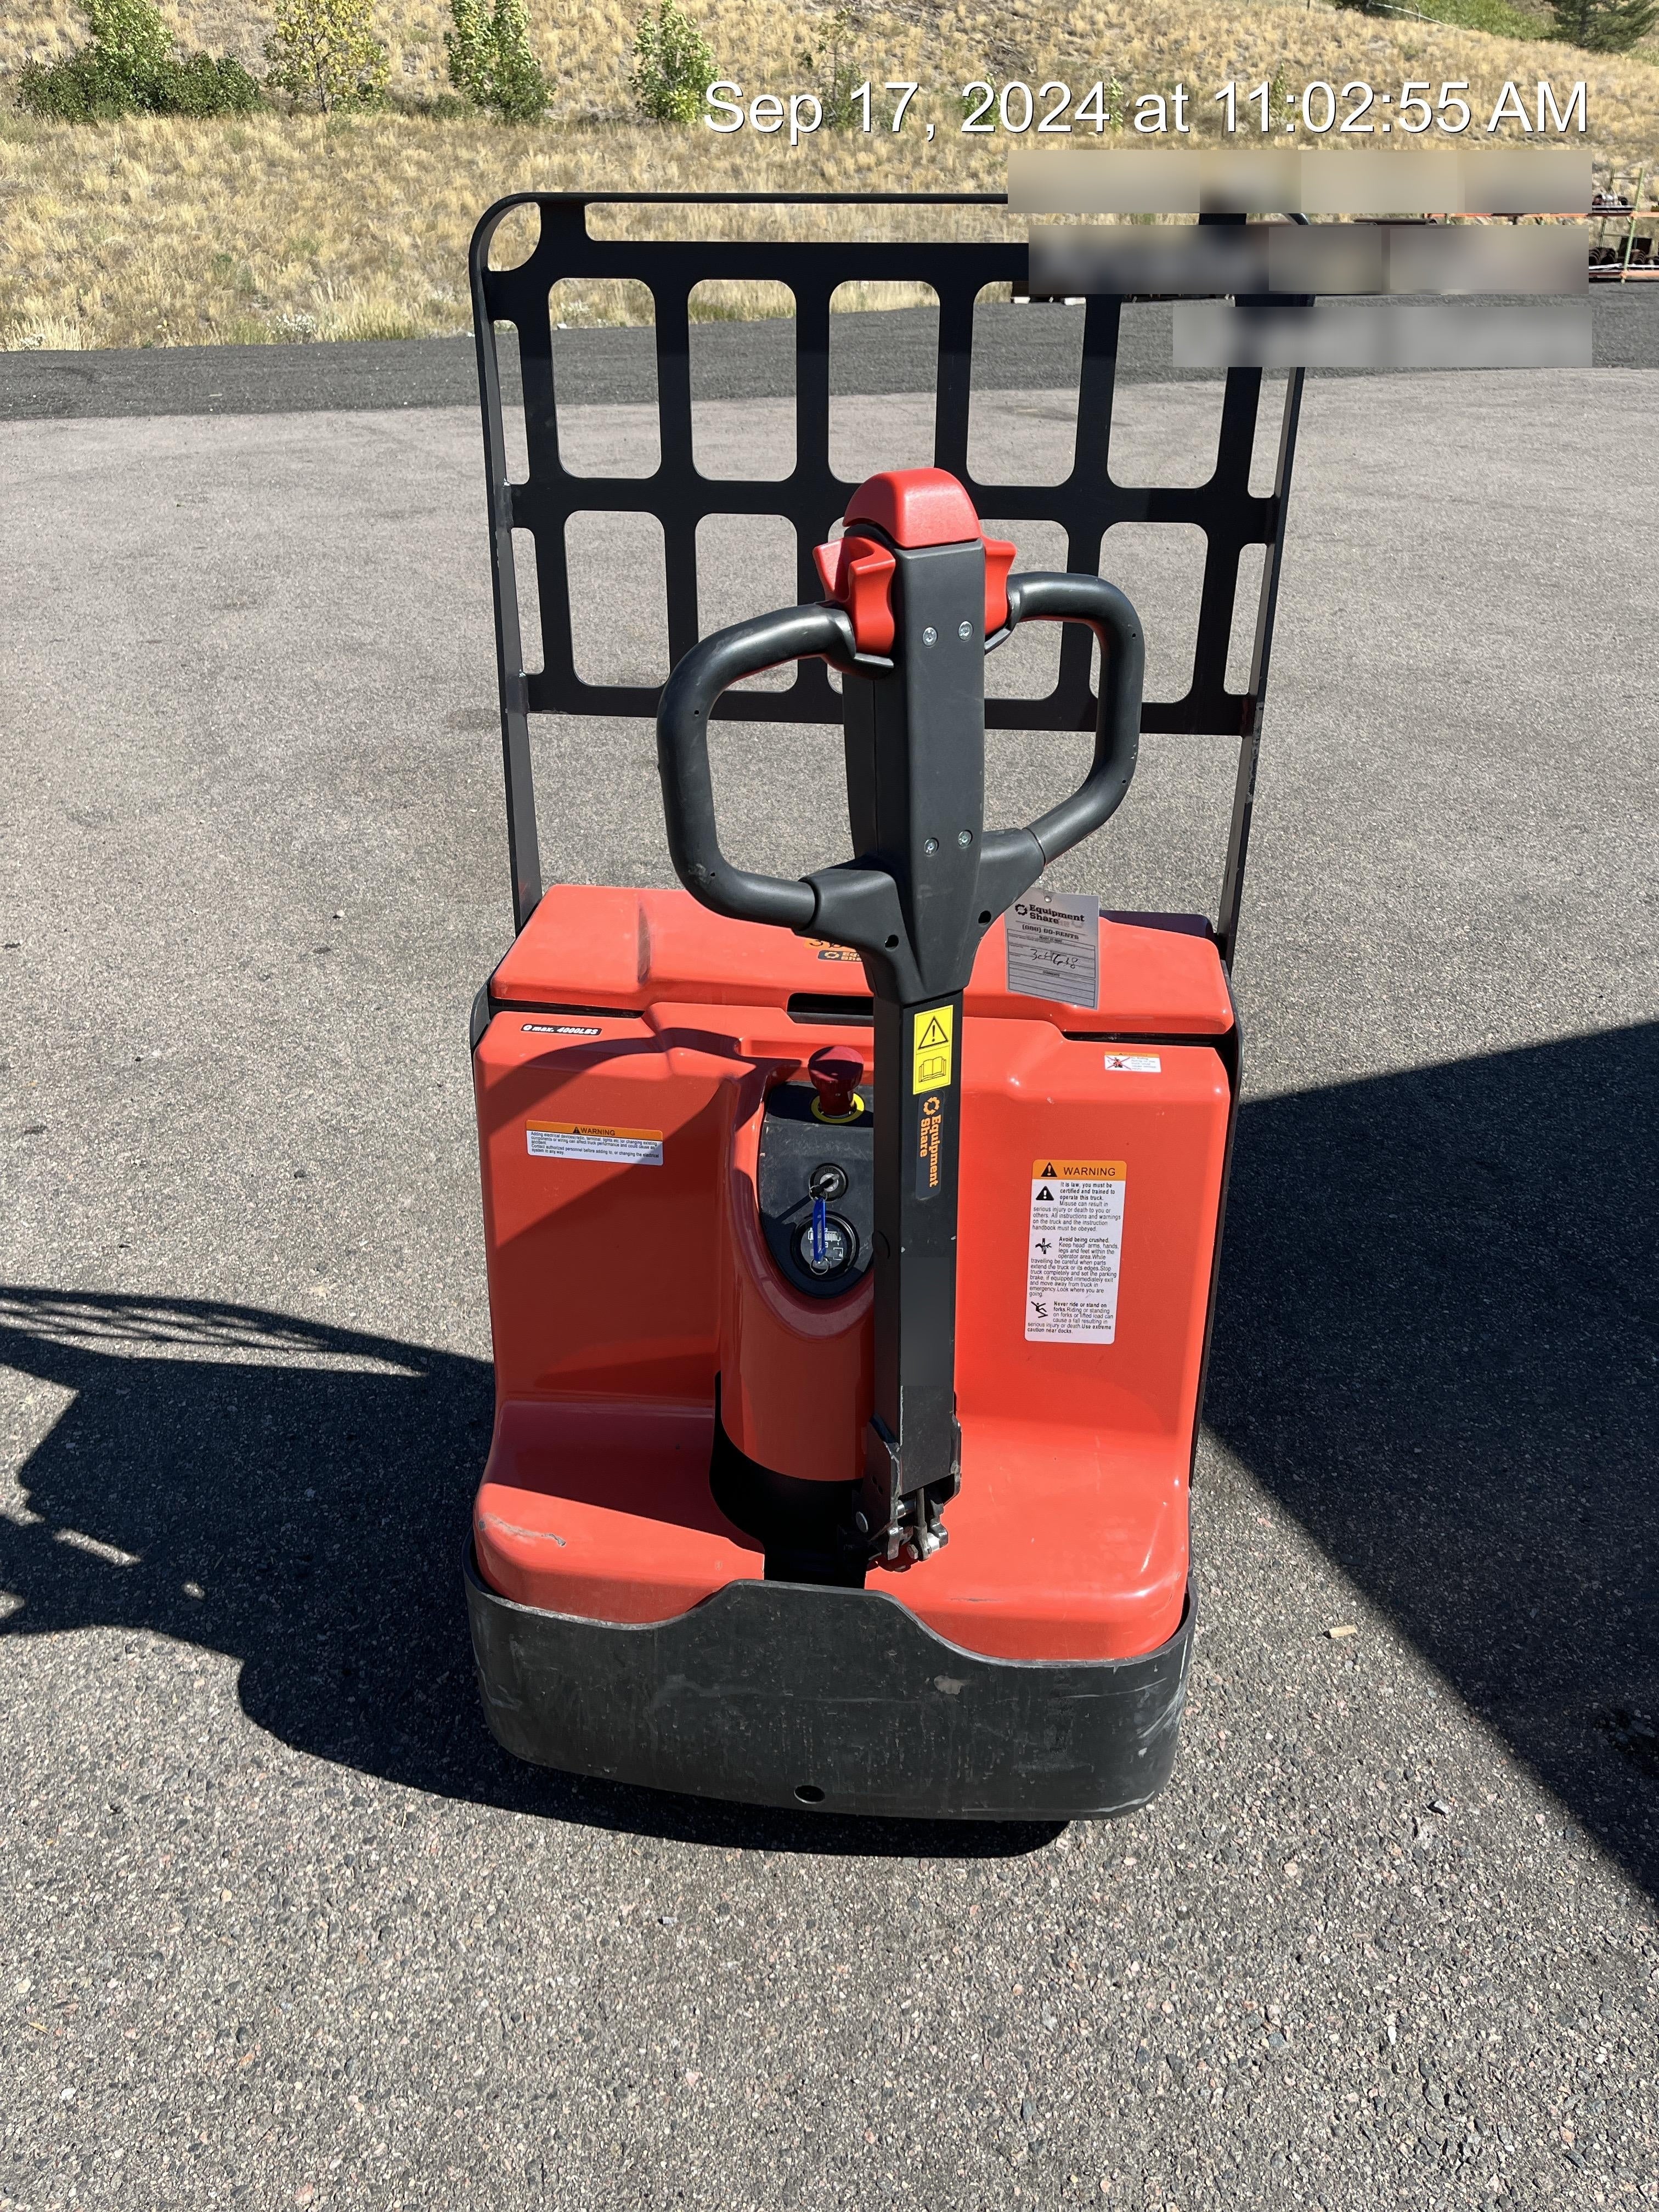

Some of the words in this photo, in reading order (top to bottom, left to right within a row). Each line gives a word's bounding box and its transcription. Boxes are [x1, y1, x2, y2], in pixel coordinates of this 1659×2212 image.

[1029, 904, 1085, 922] Equipment
[1030, 912, 1059, 924] Share
[580, 1127, 615, 1136] WARNING
[920, 1118, 930, 1157] Share
[929, 1114, 941, 1187] Equipment
[1064, 1167, 1115, 1176] WARNING
